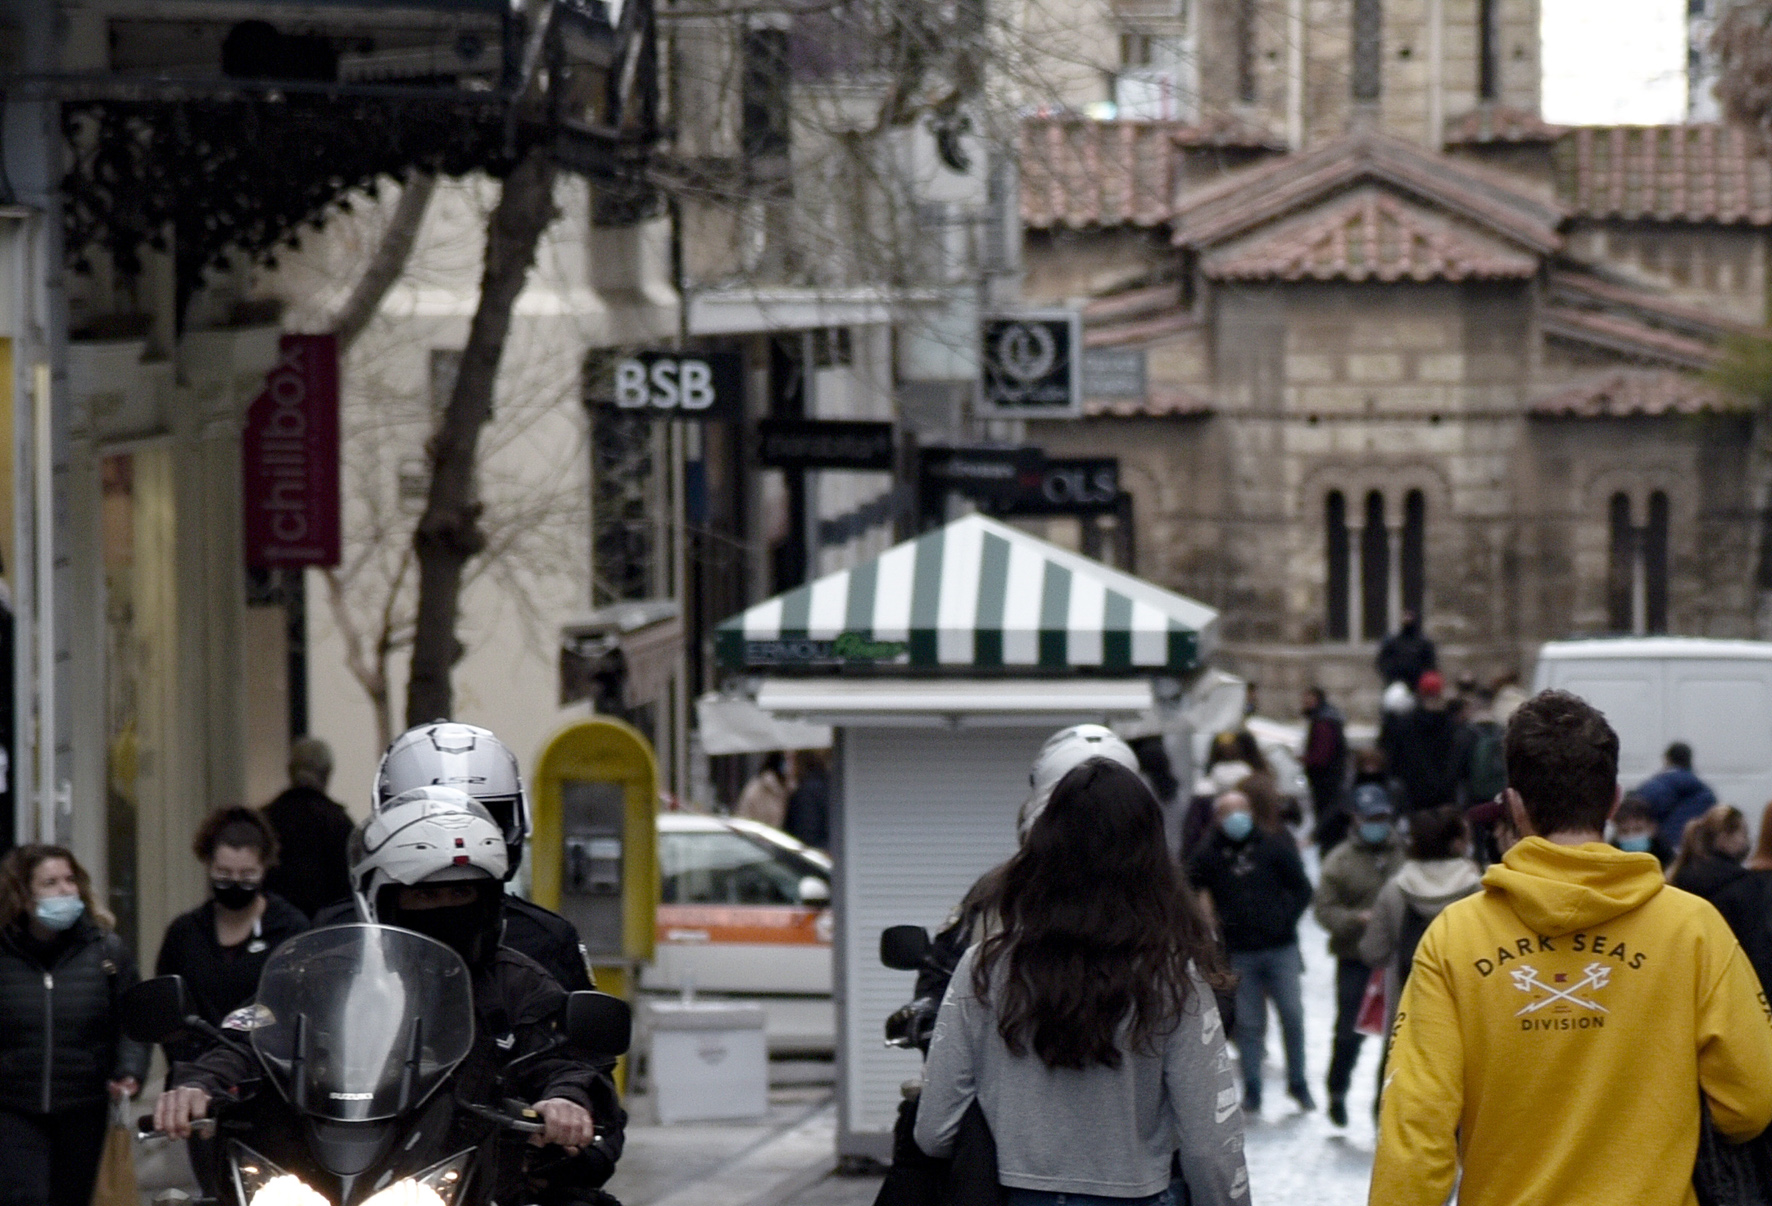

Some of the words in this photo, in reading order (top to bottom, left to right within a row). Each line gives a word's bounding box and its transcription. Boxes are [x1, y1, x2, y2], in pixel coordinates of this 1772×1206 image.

[616, 359, 715, 409] BSB
[1473, 935, 1556, 978] DARK
[1572, 933, 1647, 970] SEAS
[1521, 1016, 1605, 1031] DIVISION
